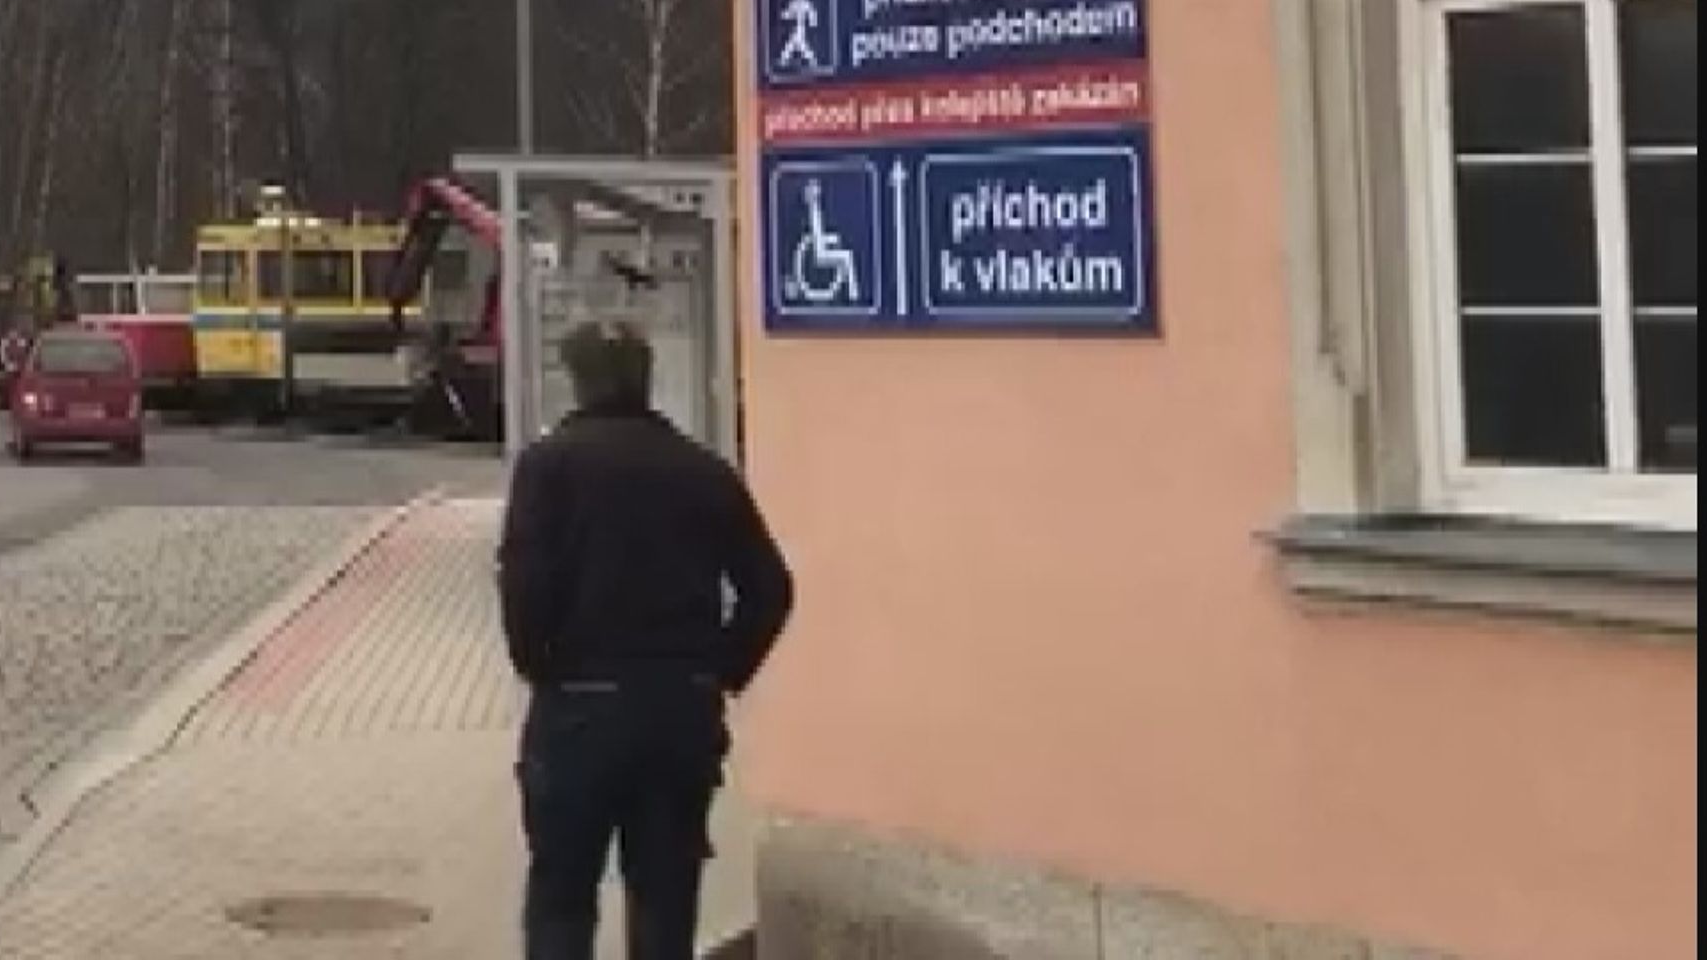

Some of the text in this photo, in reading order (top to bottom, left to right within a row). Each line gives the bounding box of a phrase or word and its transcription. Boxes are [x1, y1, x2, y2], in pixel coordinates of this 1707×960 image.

[946, 0, 1136, 59] podchodem
[952, 178, 1106, 243] příchod
[940, 243, 1123, 292] k vlakům
